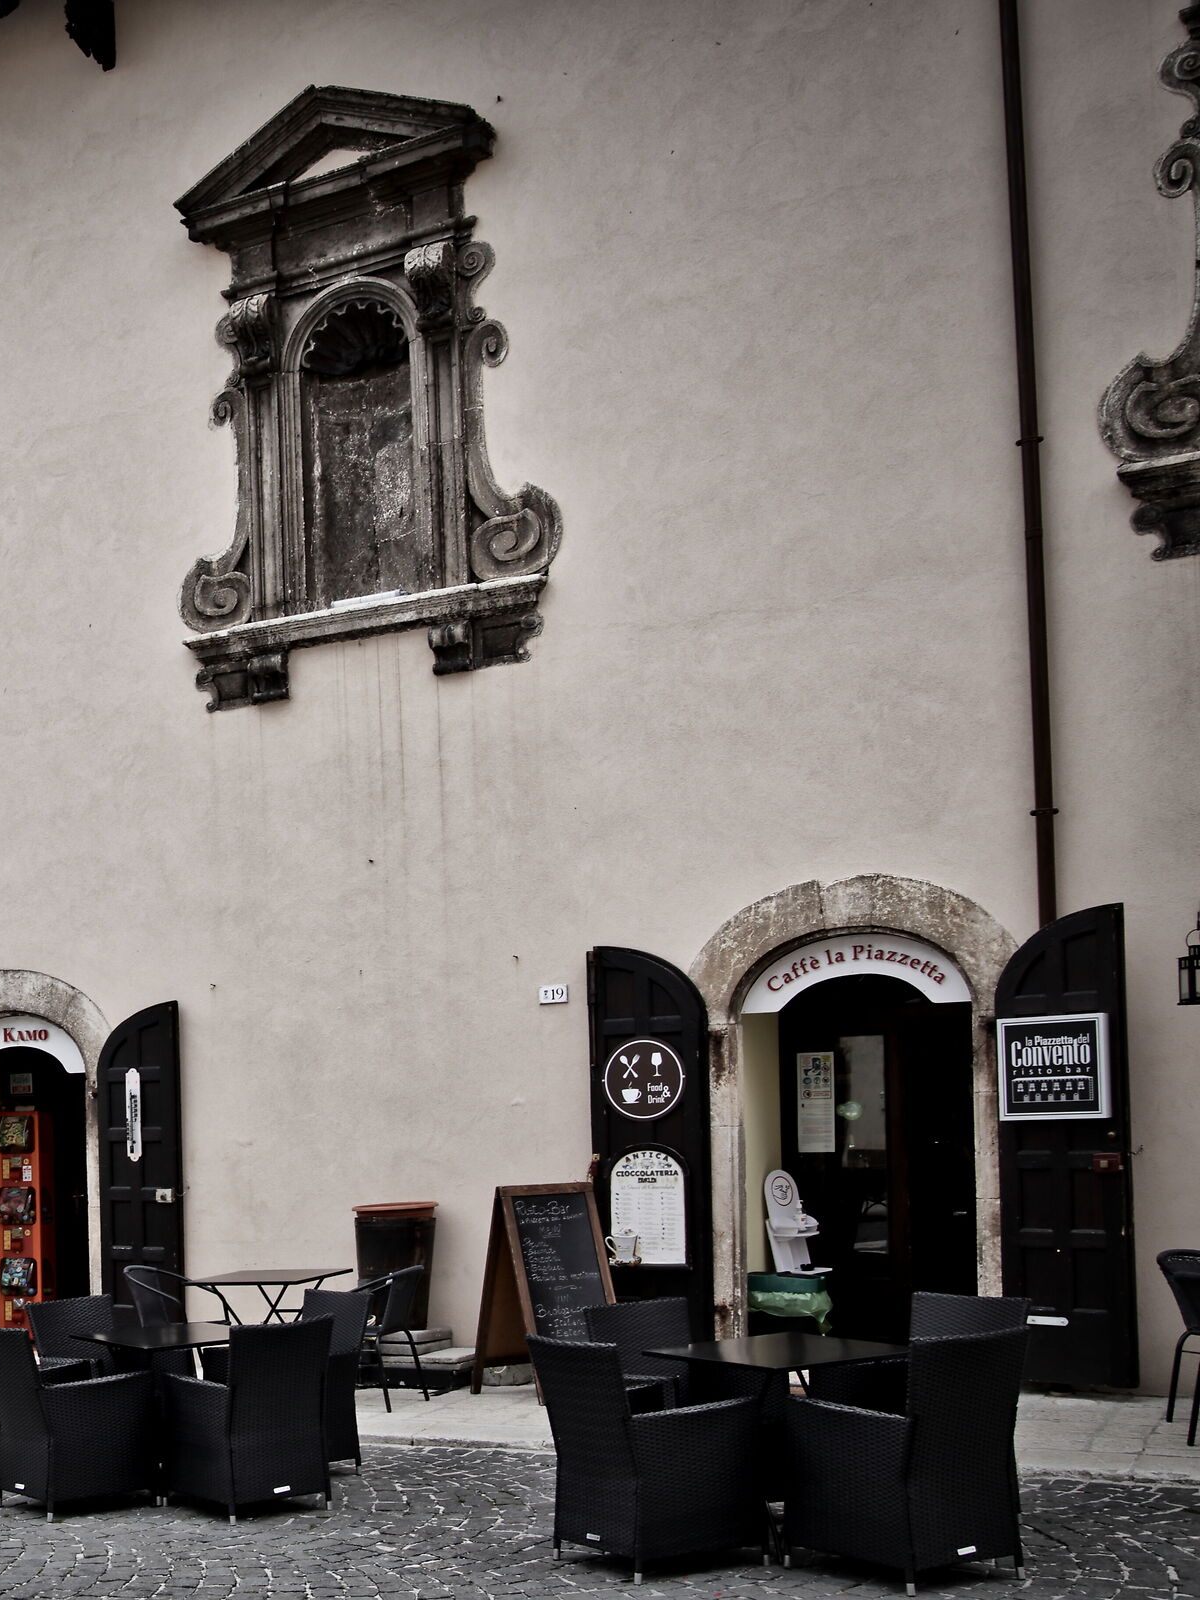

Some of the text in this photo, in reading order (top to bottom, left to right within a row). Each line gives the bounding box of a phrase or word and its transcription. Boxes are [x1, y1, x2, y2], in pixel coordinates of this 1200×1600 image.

[767, 944, 947, 992] Caffè la Piazzetta
[551, 987, 564, 1000] 19
[1025, 1033, 1090, 1047] la Piazzetta del
[1010, 1038, 1091, 1068] Convento
[1012, 1066, 1091, 1076] risto-bar
[647, 1082, 671, 1097] Food &
[647, 1094, 665, 1104] Drink
[625, 1152, 670, 1163] ANTICA
[615, 1170, 679, 1178] CIOCCOLATERIA
